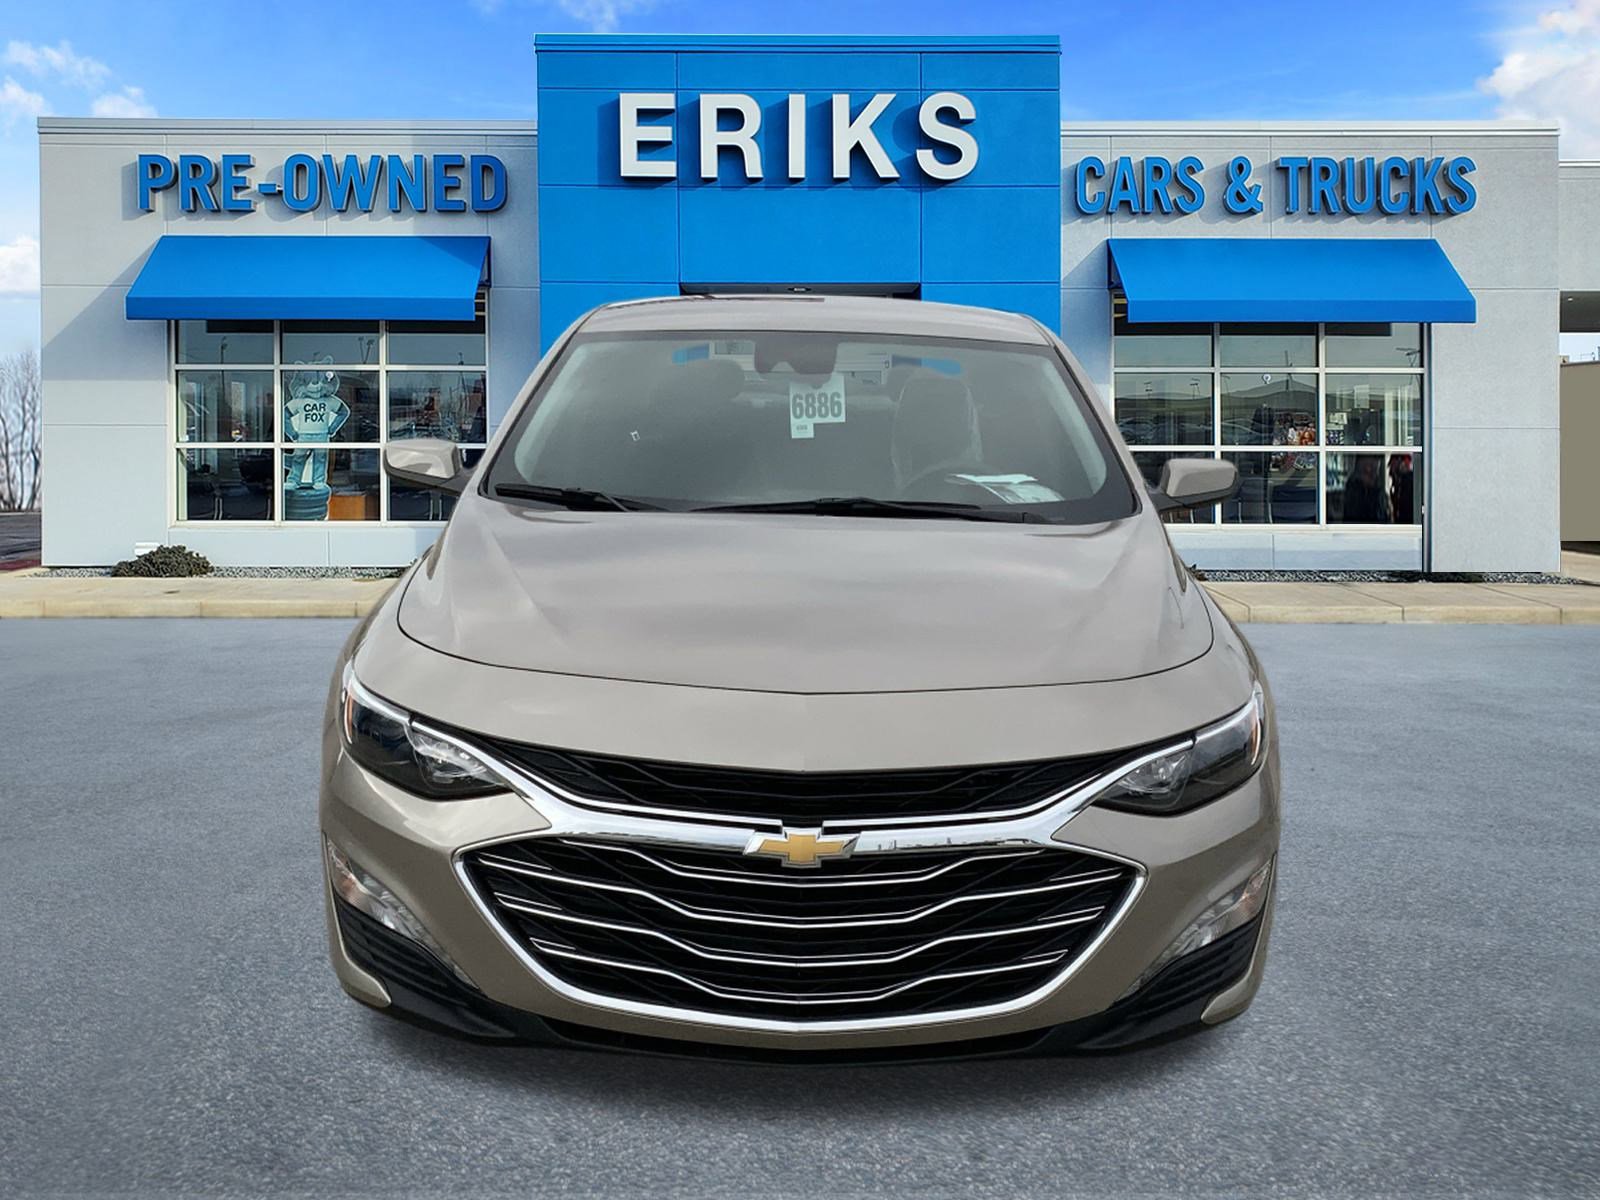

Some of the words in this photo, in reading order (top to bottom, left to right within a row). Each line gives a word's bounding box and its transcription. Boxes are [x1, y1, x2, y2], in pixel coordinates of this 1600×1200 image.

[619, 91, 979, 181] ERIKS
[138, 153, 508, 212] PRE-OWNED
[1075, 155, 1205, 215] CARS
[1224, 155, 1264, 215] &
[1278, 155, 1477, 216] TRUCKS
[303, 402, 327, 413] CAR
[304, 412, 326, 423] FOX
[792, 391, 842, 420] 6886
